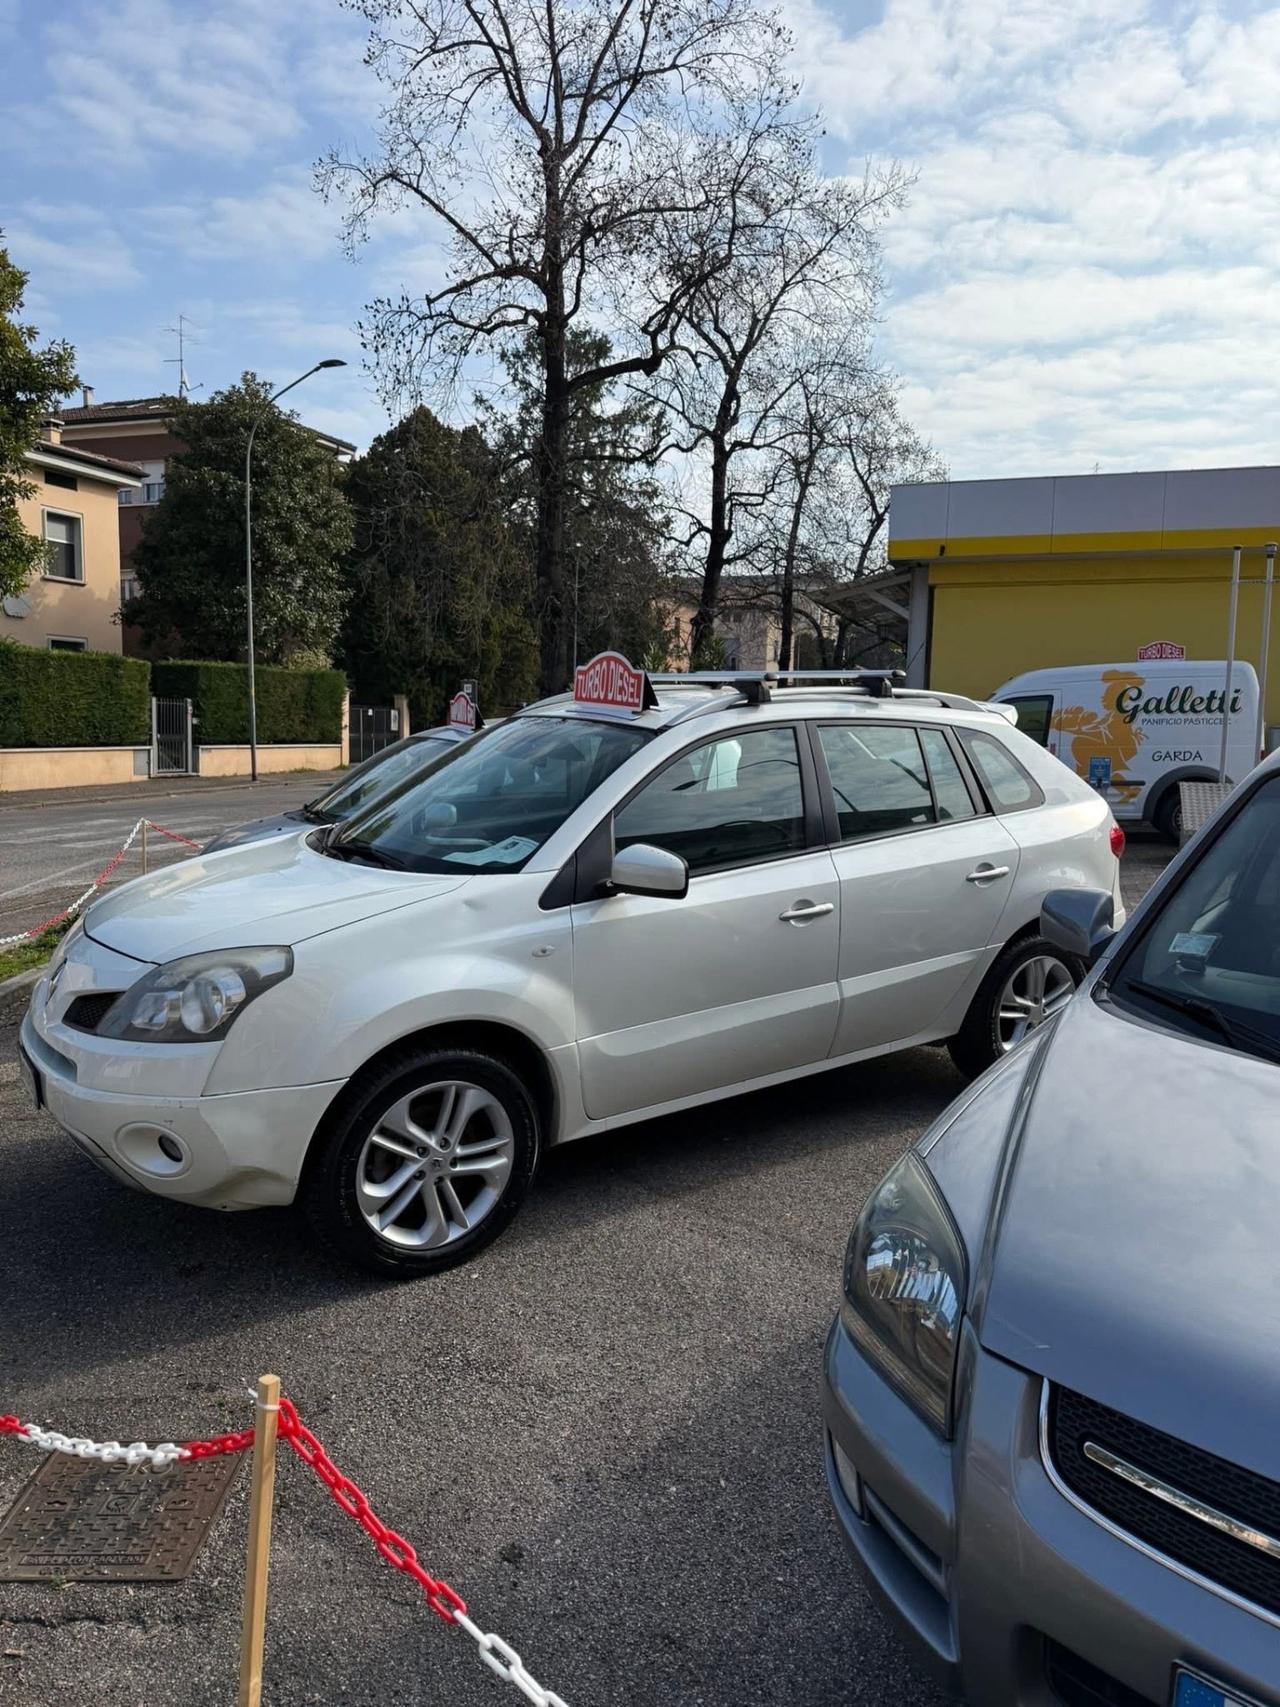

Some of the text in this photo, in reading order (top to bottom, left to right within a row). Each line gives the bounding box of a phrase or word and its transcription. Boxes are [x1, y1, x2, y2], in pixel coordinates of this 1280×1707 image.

[1161, 643, 1184, 659] DIESEL
[577, 660, 640, 703] TURBO DIESEL
[1116, 685, 1241, 724] Galletti
[1141, 717, 1182, 725] PANIFICIO
[1152, 750, 1203, 762] GARDA
